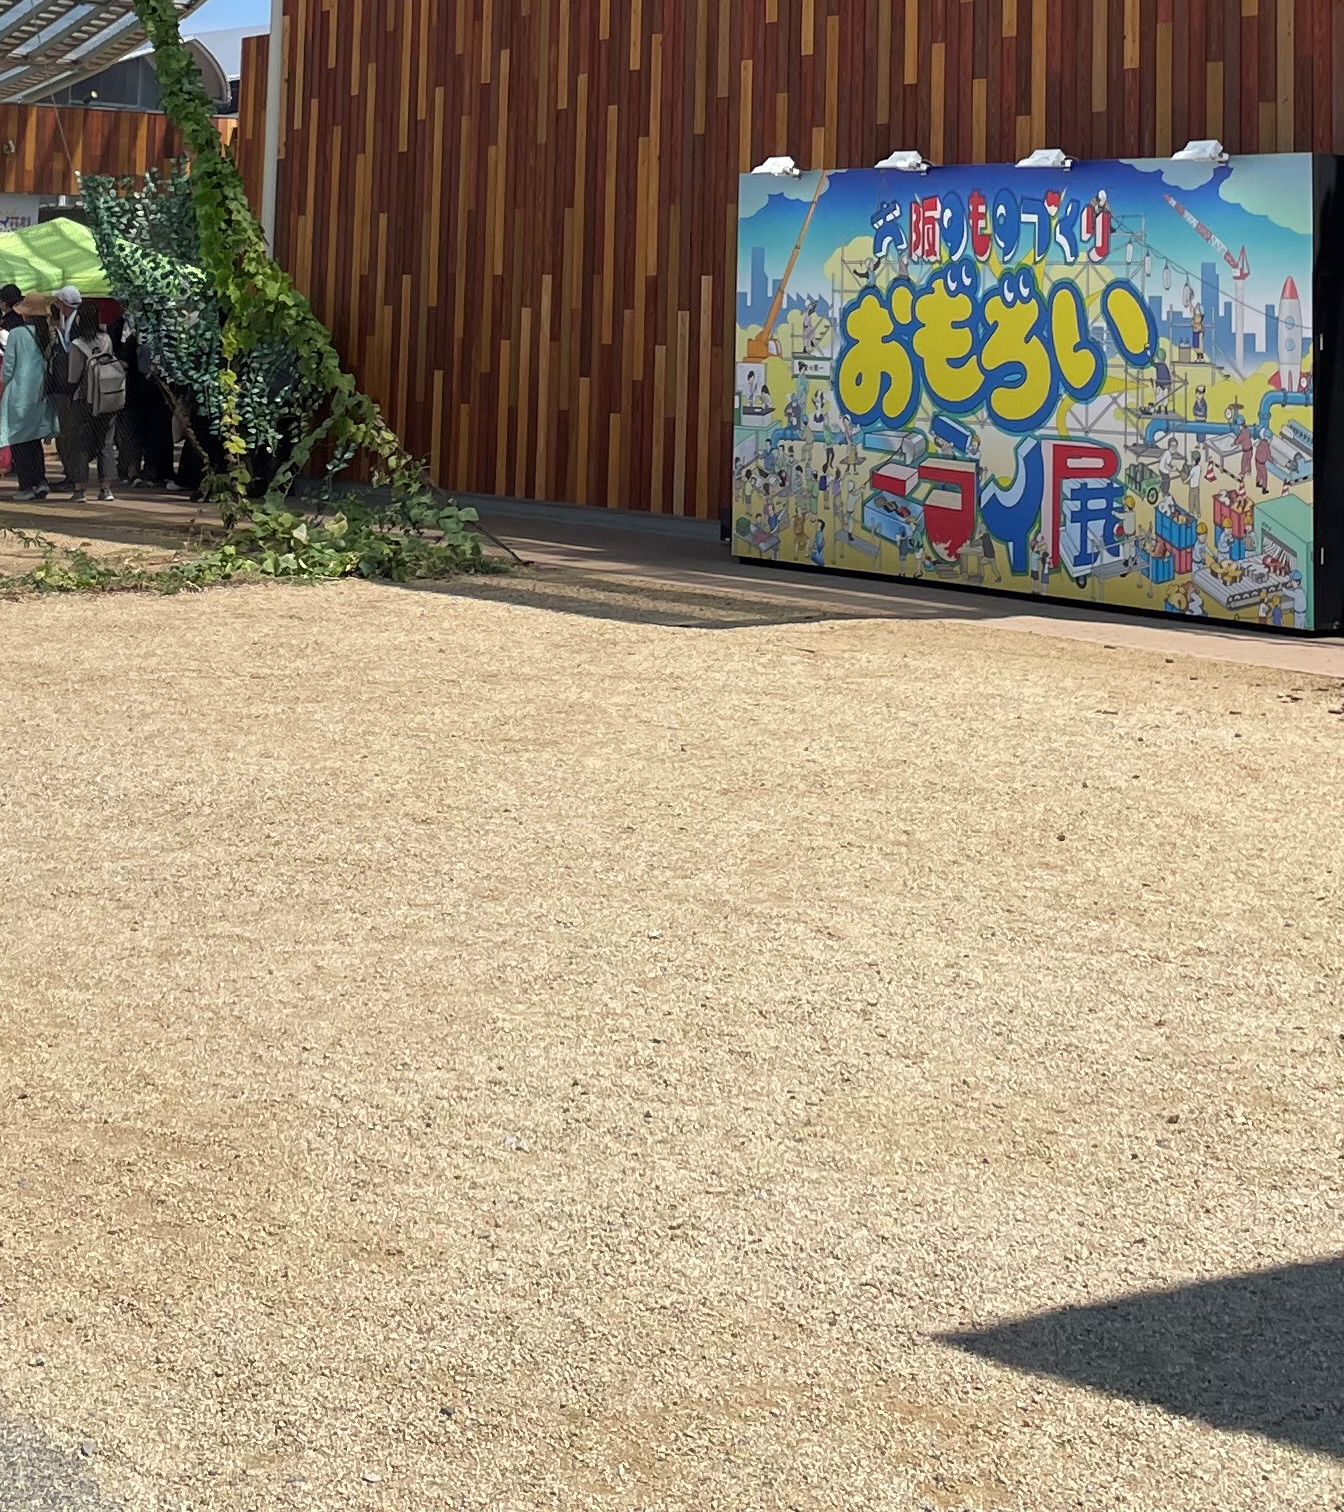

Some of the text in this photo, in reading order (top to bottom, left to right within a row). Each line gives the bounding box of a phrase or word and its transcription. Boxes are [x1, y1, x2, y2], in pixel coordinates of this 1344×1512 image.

[871, 189, 1112, 265] 大阪のものづくり
[835, 262, 1156, 430] おもろい
